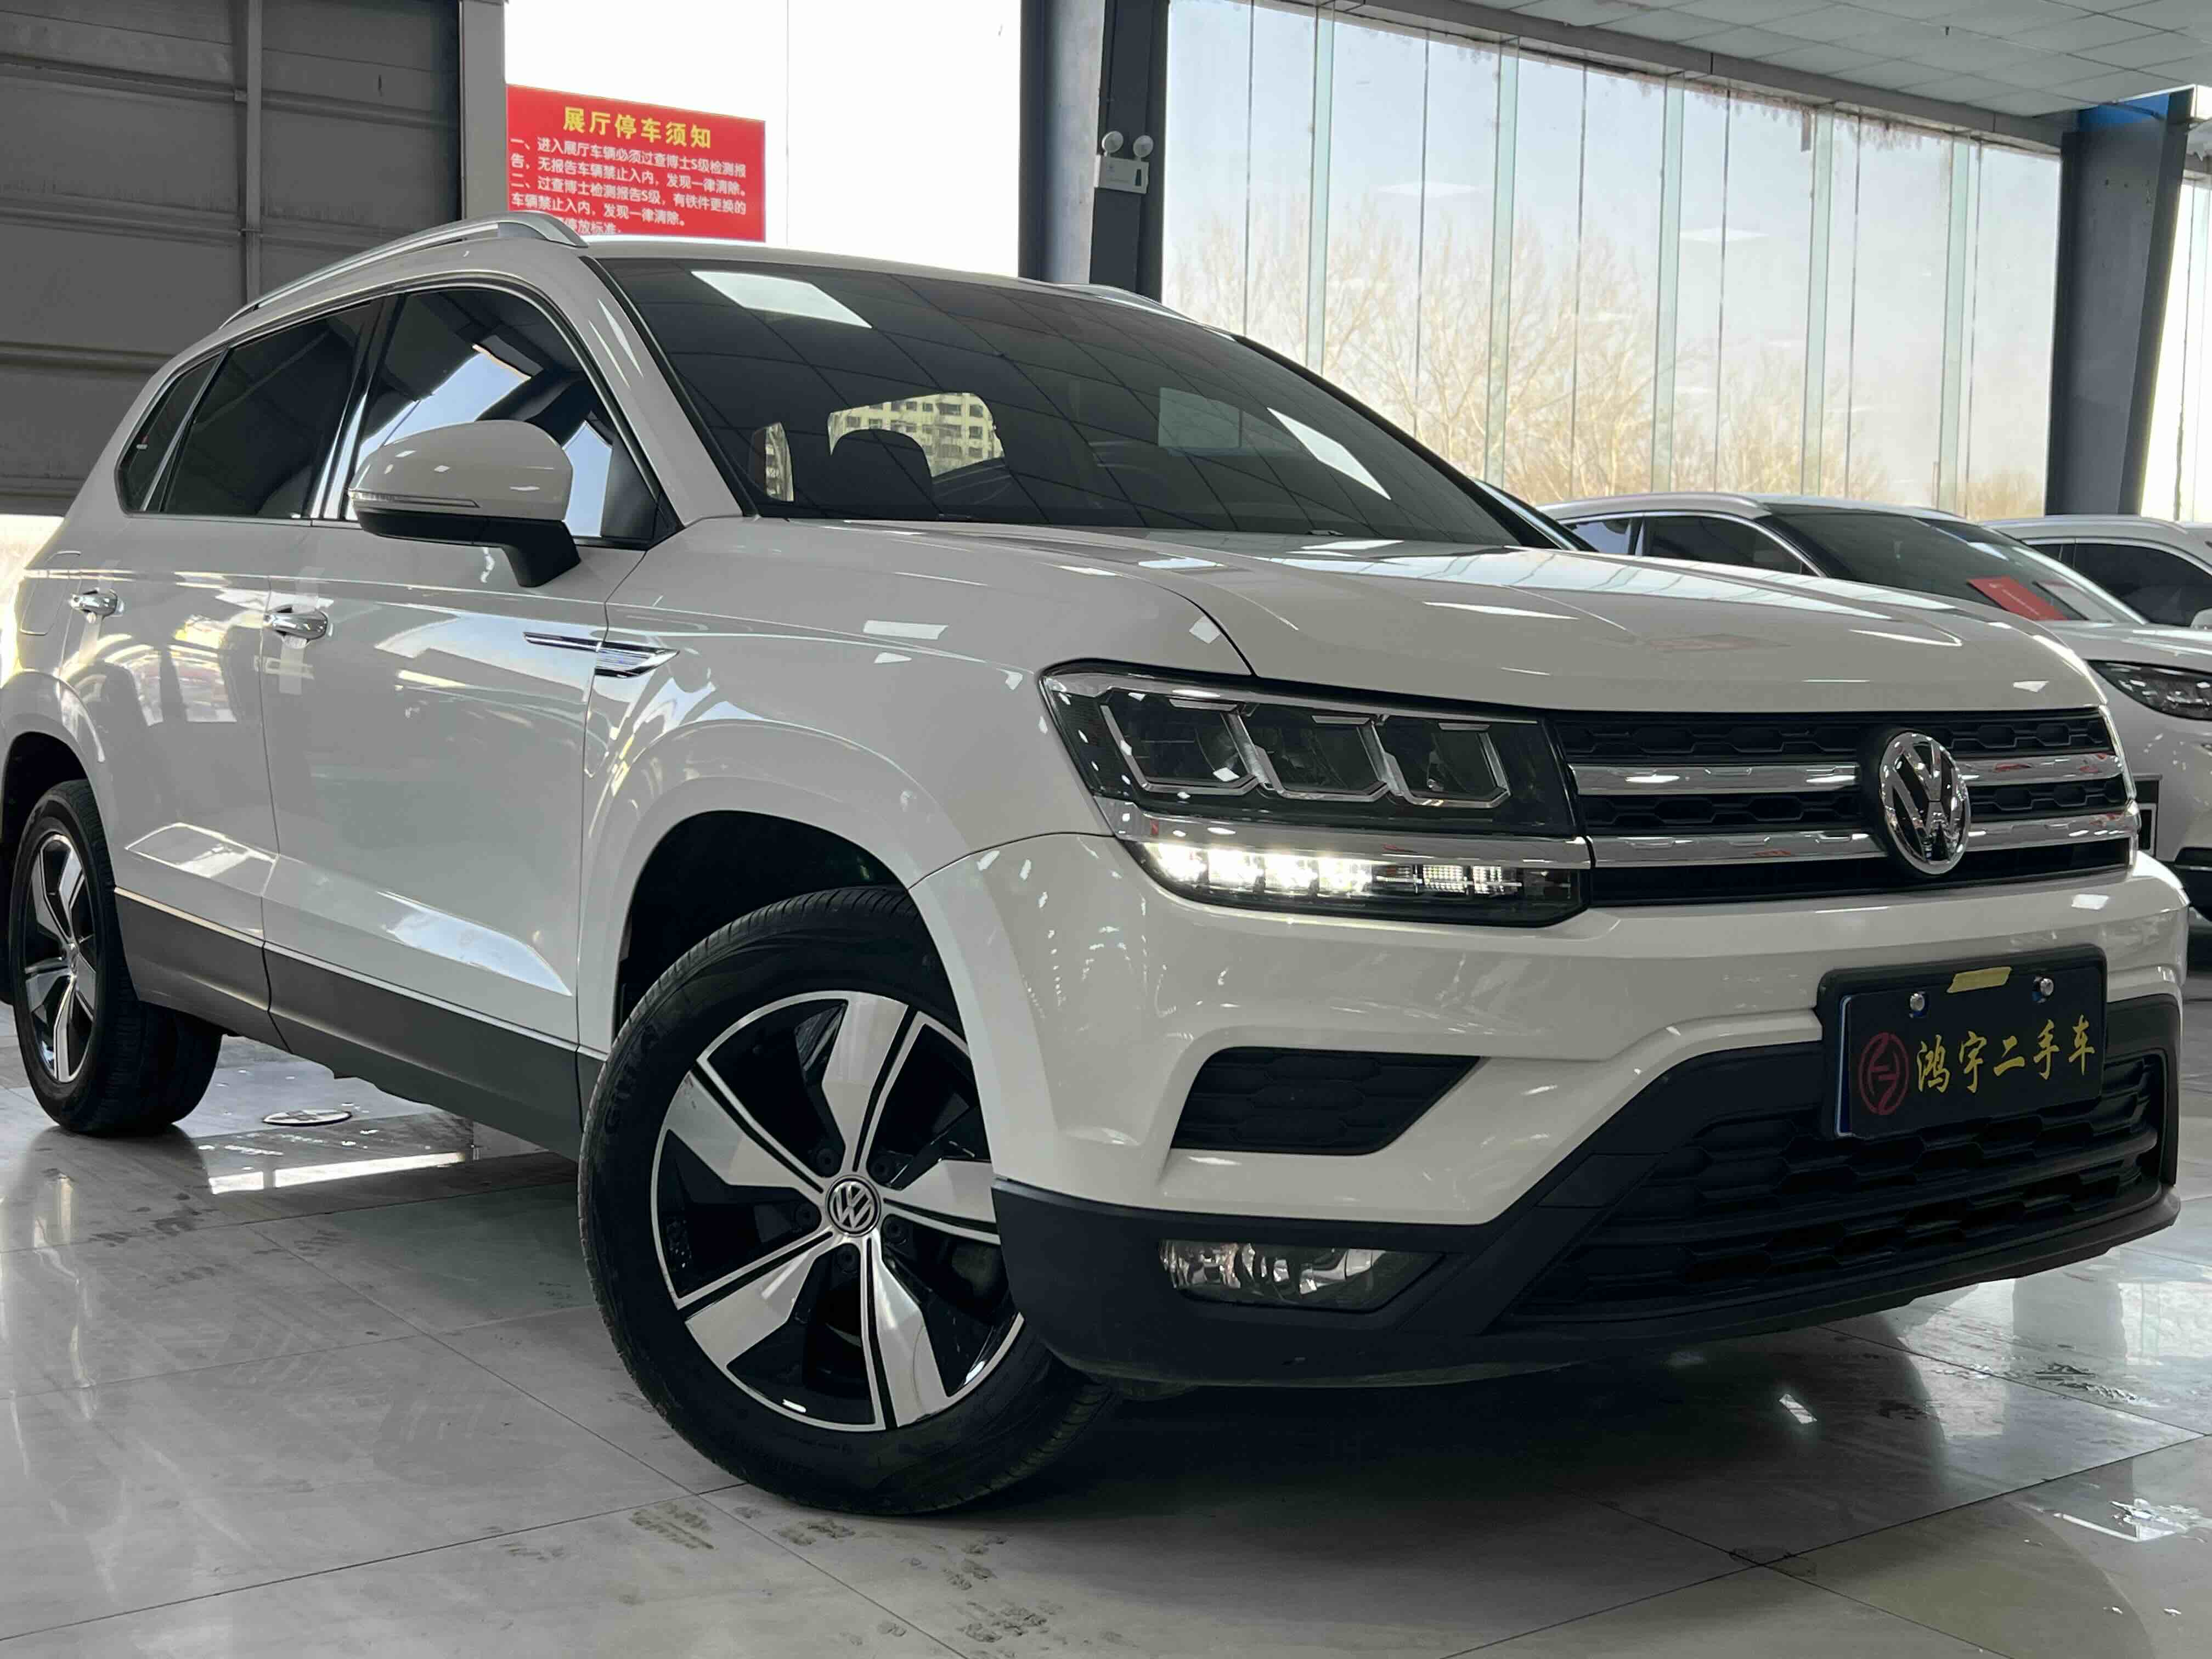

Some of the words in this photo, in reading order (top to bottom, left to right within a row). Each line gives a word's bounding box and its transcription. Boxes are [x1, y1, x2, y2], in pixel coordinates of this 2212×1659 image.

[563, 106, 711, 148] 展厅停车须知
[1917, 1014, 2095, 1093] 鸿宇二手车
